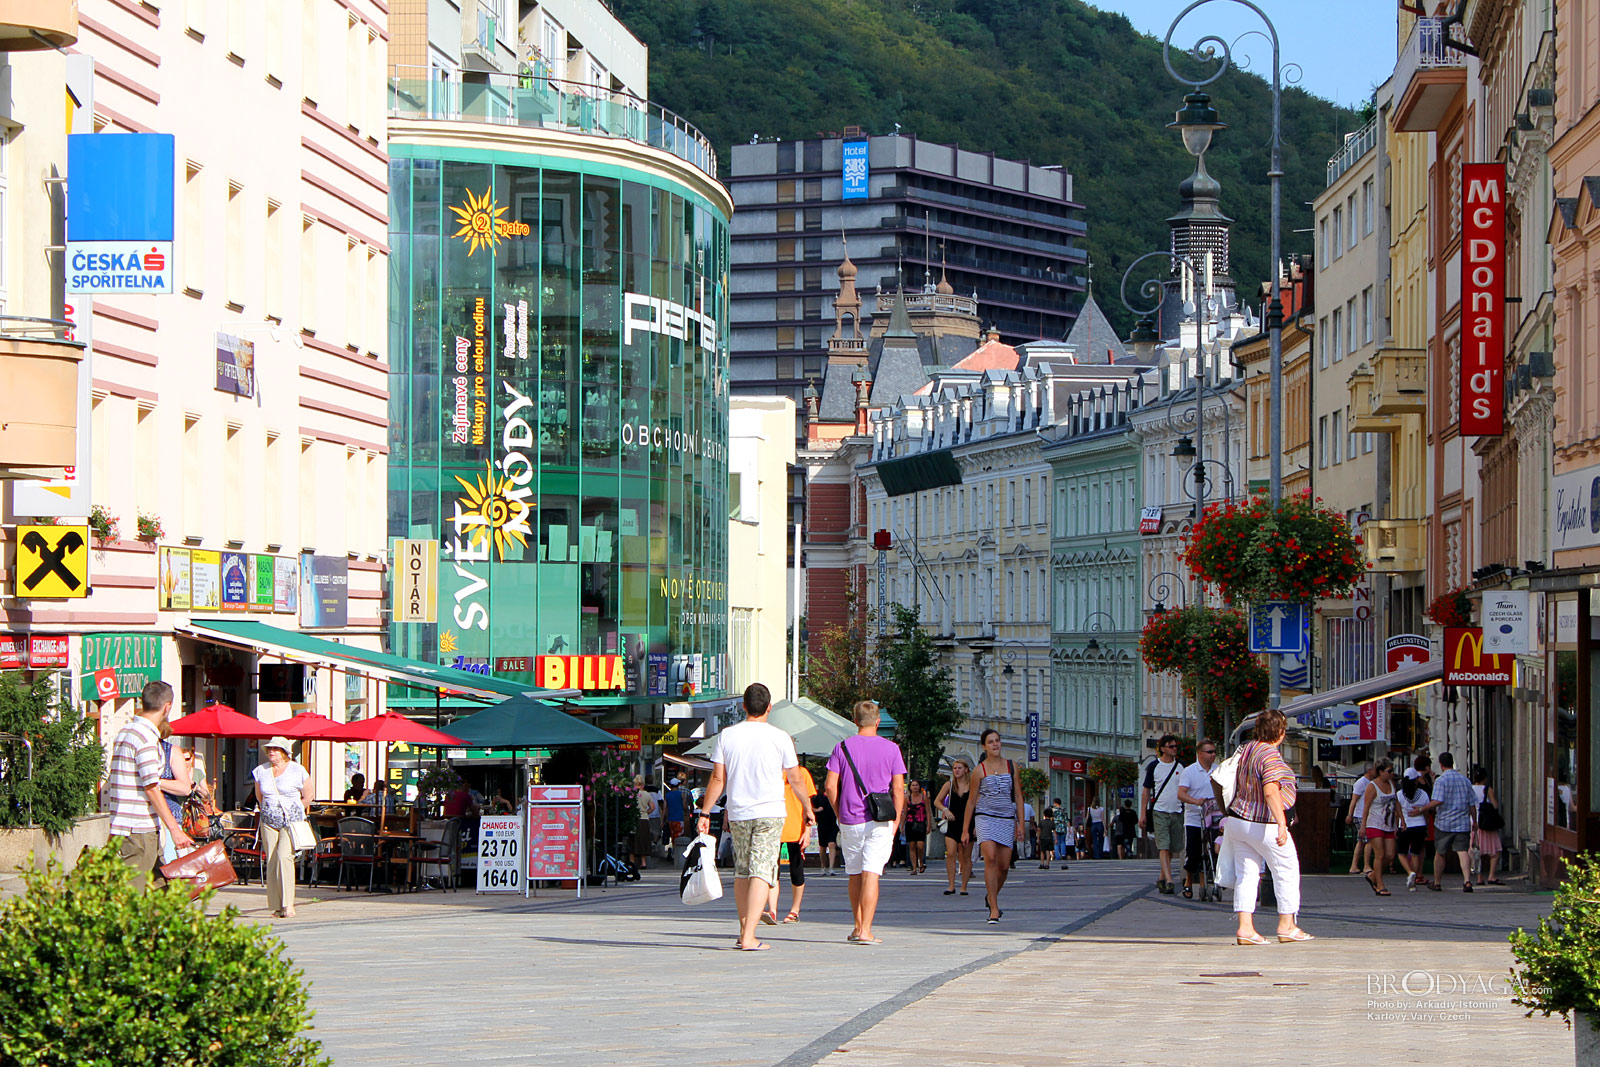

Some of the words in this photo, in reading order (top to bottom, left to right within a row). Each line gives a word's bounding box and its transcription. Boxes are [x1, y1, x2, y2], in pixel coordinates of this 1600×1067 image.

[845, 147, 866, 156] Hotel
[501, 219, 530, 236] patro
[72, 249, 142, 271] ČESKÁ
[72, 271, 165, 288] SPOŘITELNA
[1467, 179, 1500, 420] McDonald's
[472, 297, 485, 336] rodinu
[456, 335, 471, 373] ceny
[472, 340, 484, 373] celou
[474, 376, 486, 396] pro
[453, 376, 470, 443] Zajímavé
[472, 400, 486, 445] Nákupy
[622, 423, 698, 455] OBCHODNÍ
[445, 501, 489, 631] SVĚT
[495, 380, 534, 535] MÓDY
[410, 543, 422, 615] NOTÁŘ
[85, 636, 157, 670] PIZZERIE
[1388, 637, 1428, 648] WELLENSTEYN
[503, 660, 525, 670] SALE
[544, 656, 626, 690] BILLA
[1448, 672, 1510, 681] McDonald's
[508, 821, 520, 829] 0%
[481, 839, 518, 857] 2370
[483, 869, 518, 887] 1640
